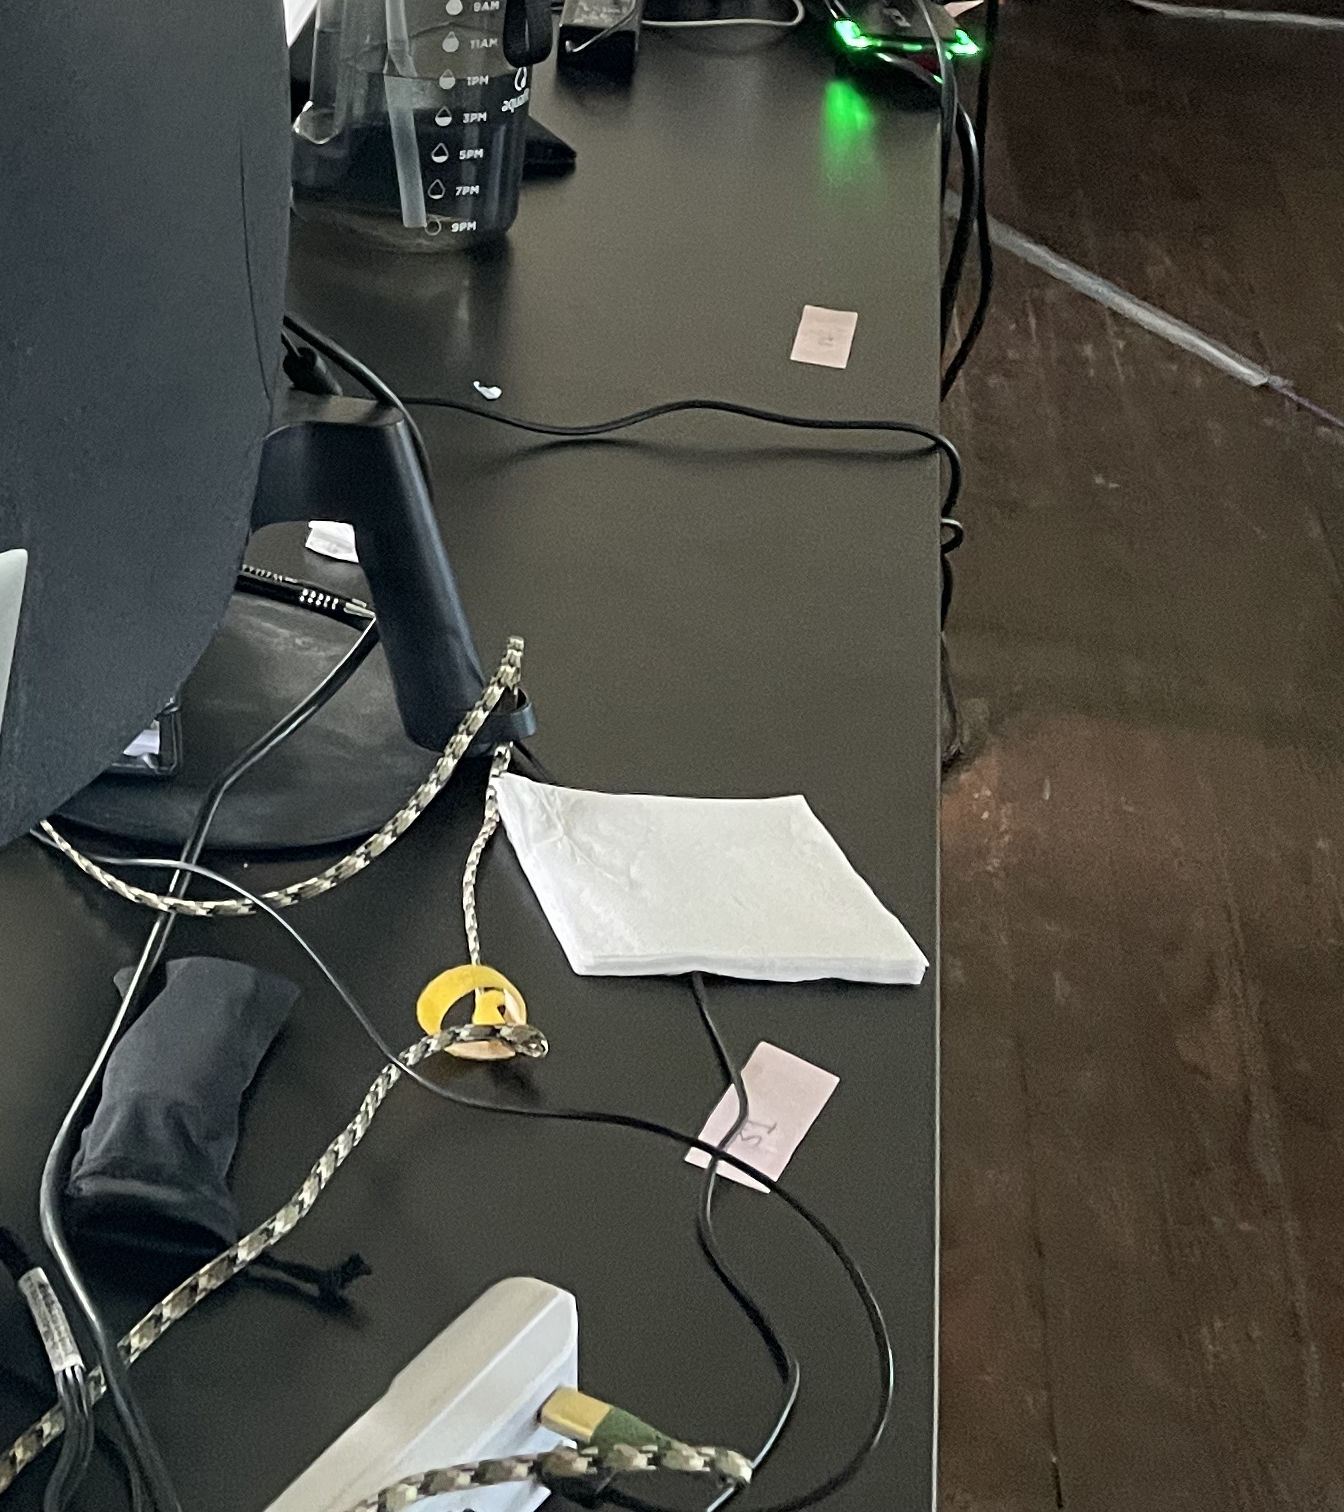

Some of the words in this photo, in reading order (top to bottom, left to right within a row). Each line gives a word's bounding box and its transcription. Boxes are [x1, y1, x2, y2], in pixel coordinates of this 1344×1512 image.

[466, 74, 489, 87] 1PM
[462, 111, 488, 124] 3PM
[459, 148, 484, 160] 5PM
[455, 185, 480, 197] 7PM
[451, 221, 477, 233] 9PM
